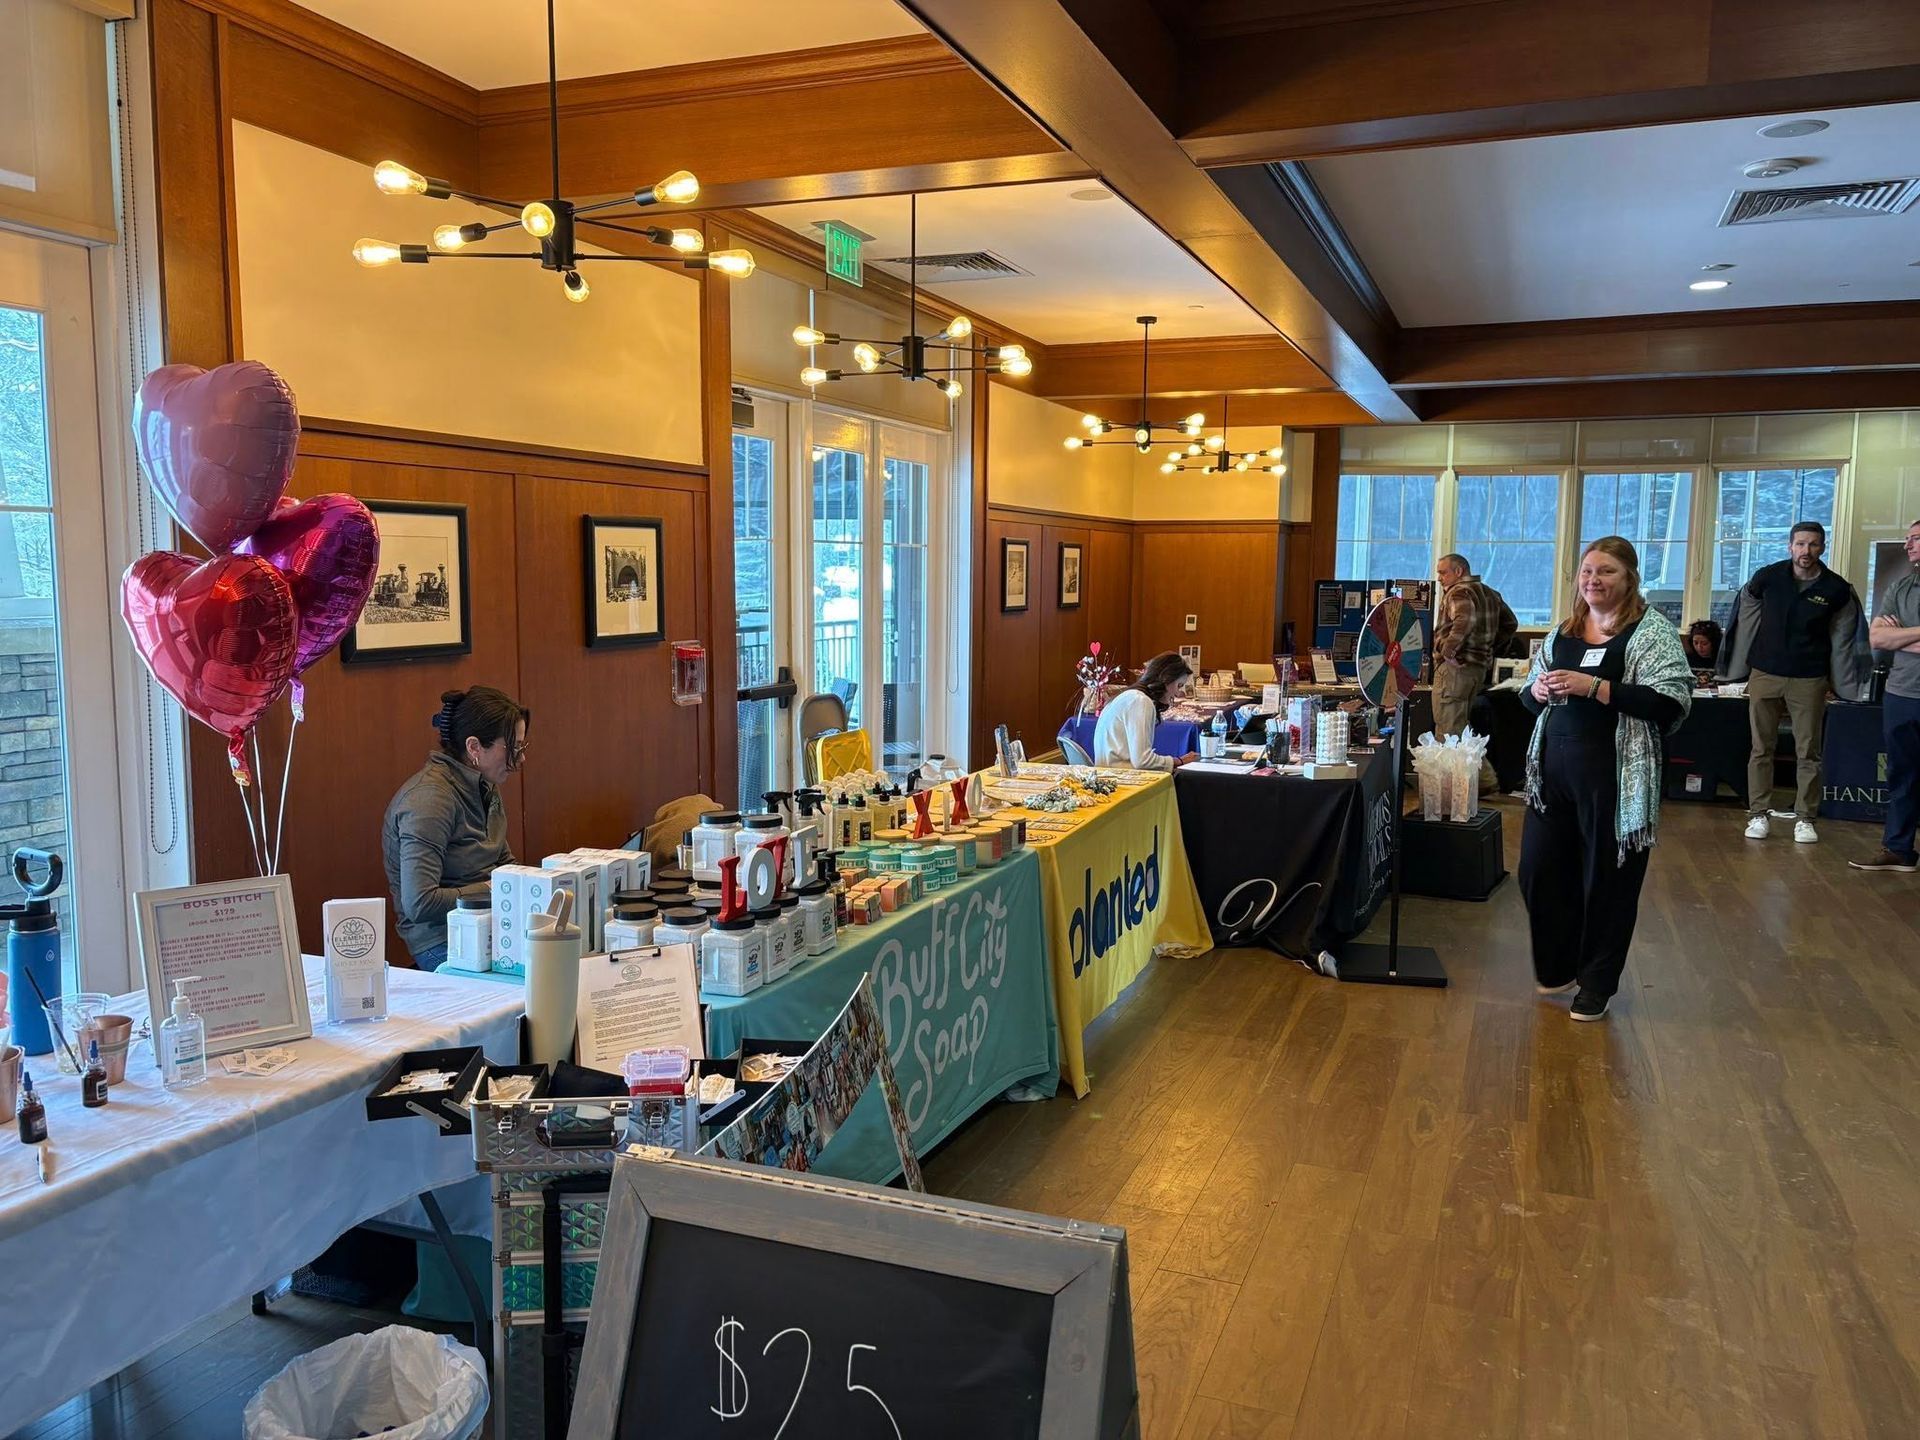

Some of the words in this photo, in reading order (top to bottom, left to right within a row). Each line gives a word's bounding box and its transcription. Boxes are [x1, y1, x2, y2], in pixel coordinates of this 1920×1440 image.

[833, 230, 860, 280] EXIT
[183, 898, 218, 910] BOSS
[224, 892, 262, 904] BITCH
[960, 886, 1008, 991] City
[1069, 825, 1160, 979] planted
[904, 995, 988, 1133] Soap
[710, 1315, 905, 1440] $25
